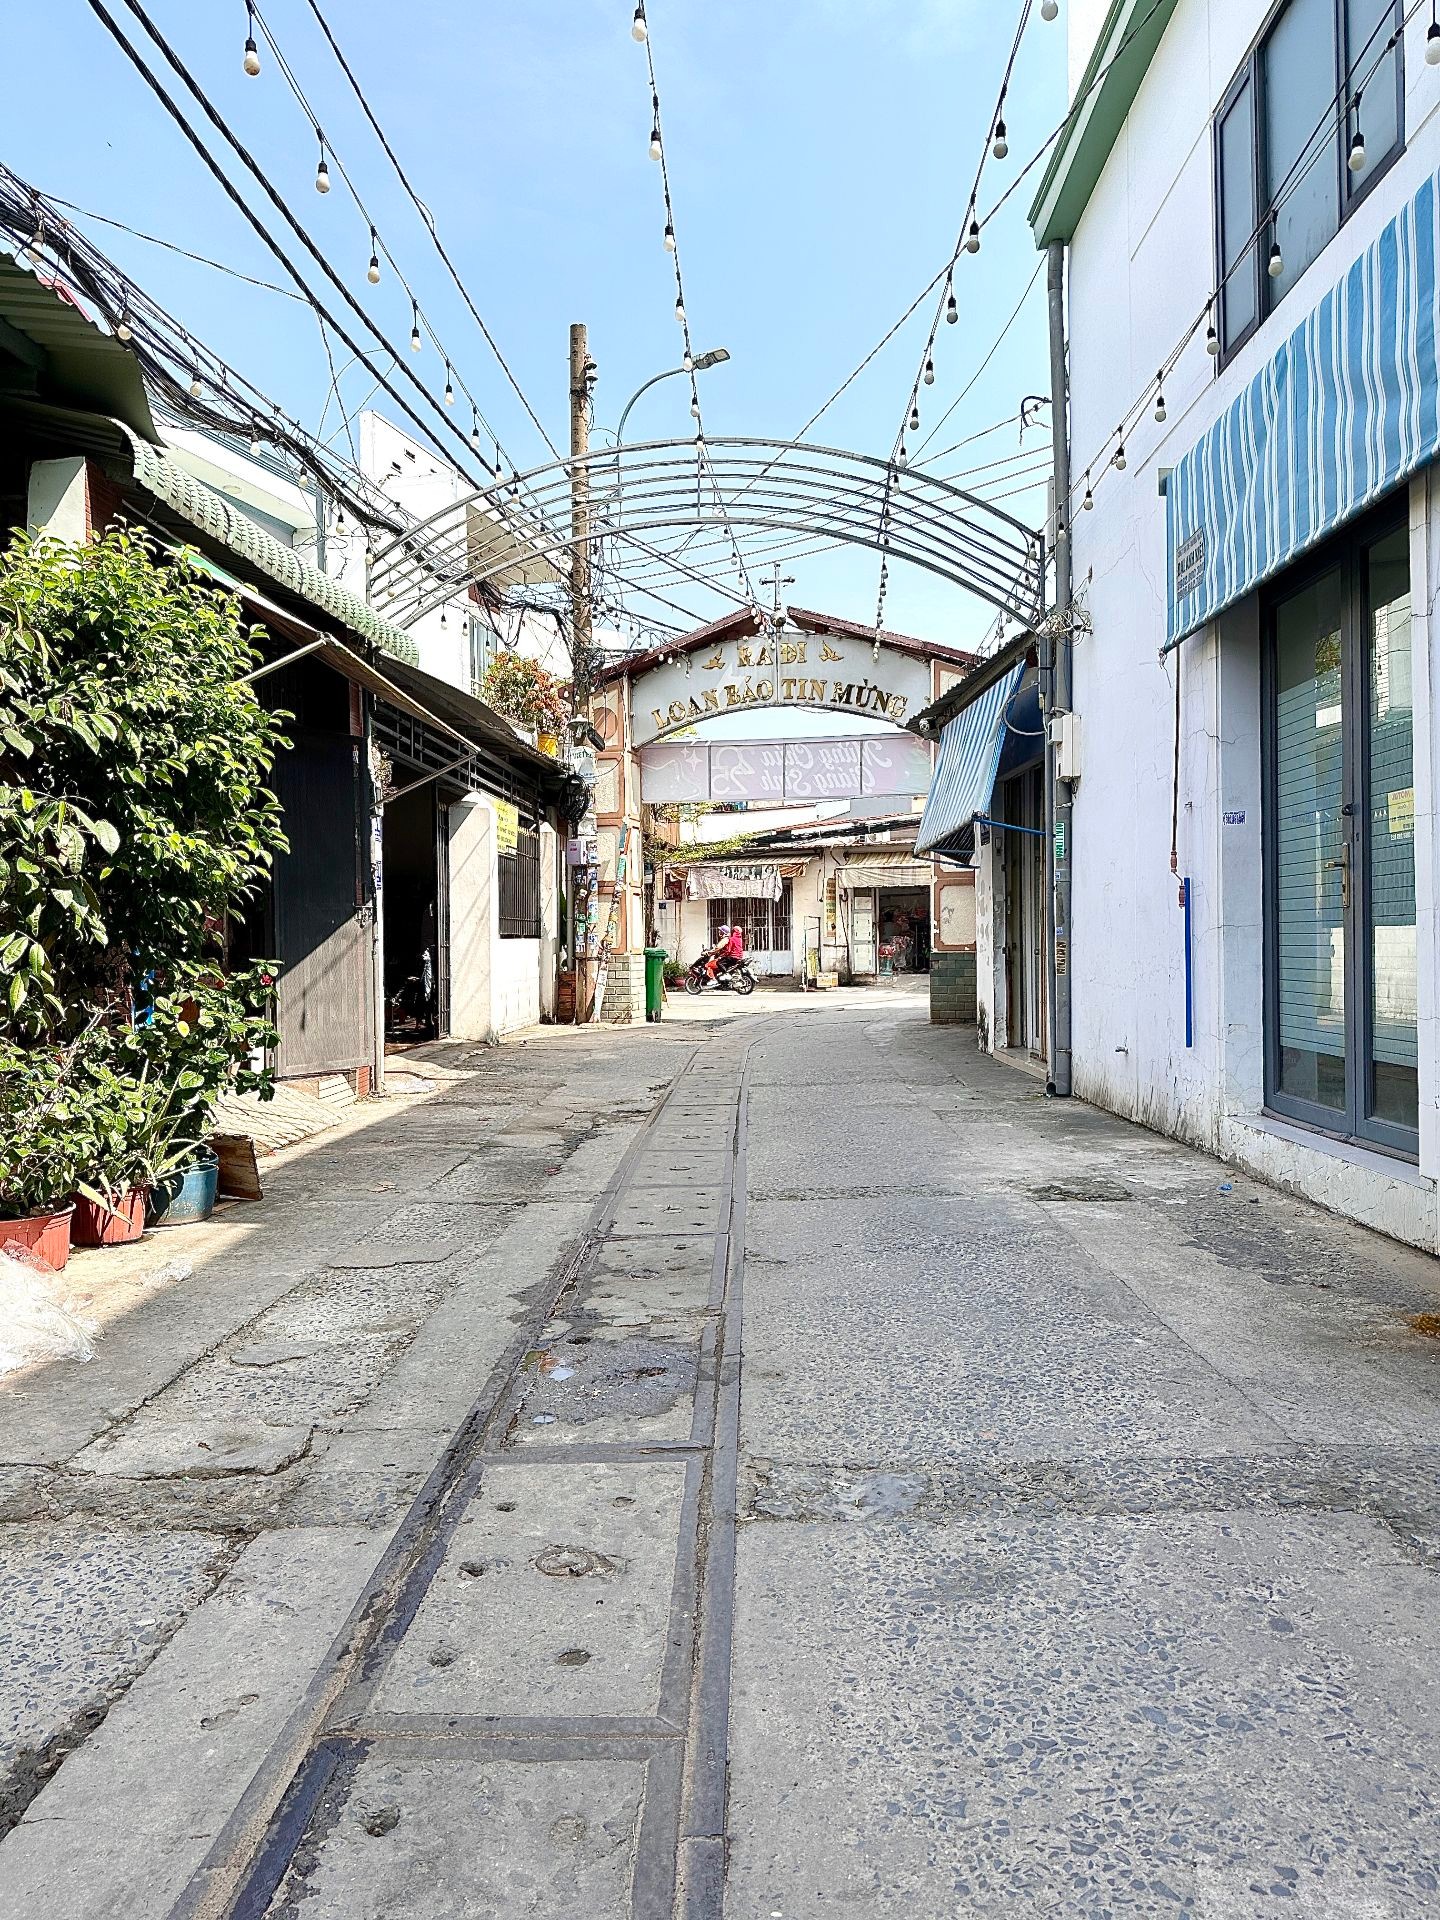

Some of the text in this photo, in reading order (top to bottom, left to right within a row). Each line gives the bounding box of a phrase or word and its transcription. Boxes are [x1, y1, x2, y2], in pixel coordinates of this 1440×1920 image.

[737, 641, 808, 668] RA ĐI
[651, 675, 908, 731] LOAN BÁO TIN MỪNG
